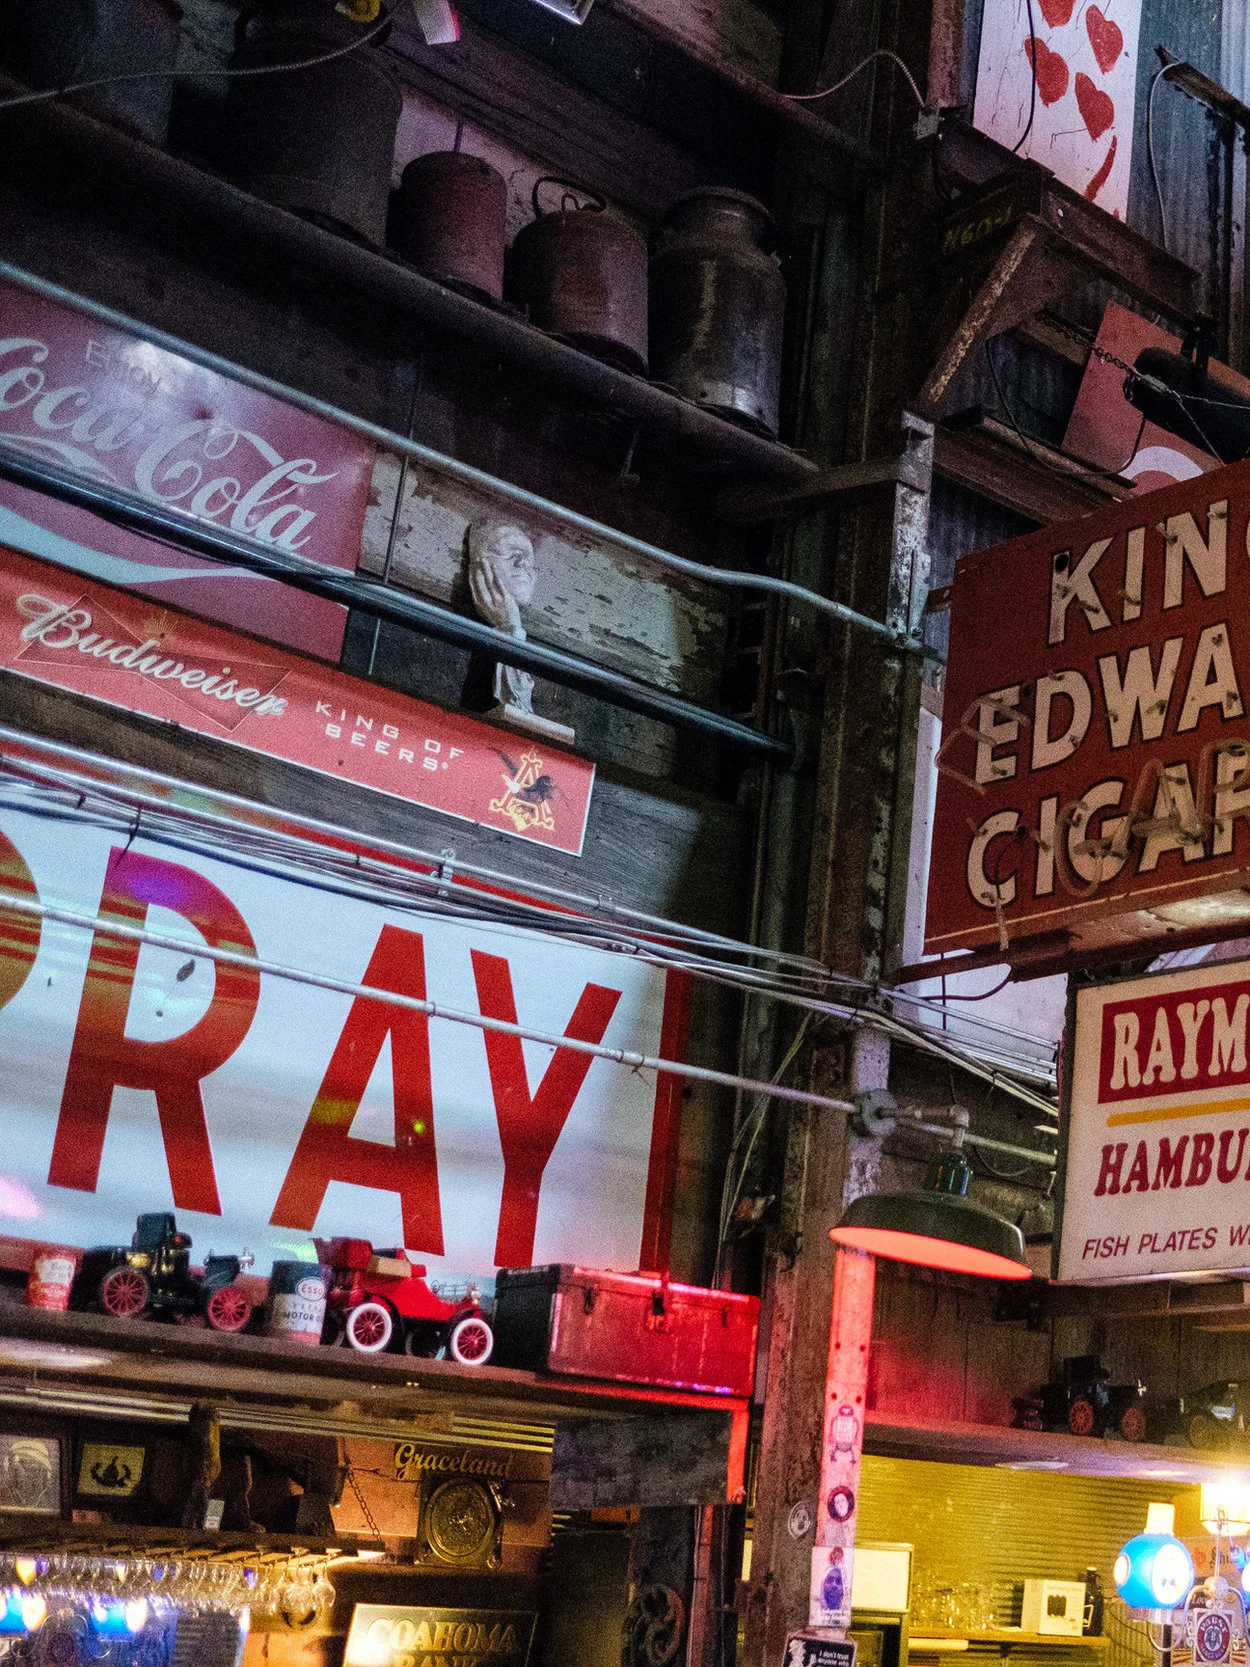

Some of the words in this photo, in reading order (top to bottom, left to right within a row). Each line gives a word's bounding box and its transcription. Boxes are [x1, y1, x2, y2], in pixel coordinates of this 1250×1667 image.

[16, 593, 290, 716] Budweiser
[315, 700, 400, 740] KING
[424, 738, 464, 760] OF
[0, 828, 622, 1267] RAY
[1082, 1235, 1131, 1260] FISH
[1137, 1226, 1219, 1255] PLATES
[395, 1443, 514, 1479] Graceland
[367, 1618, 518, 1652] COAHOMA
